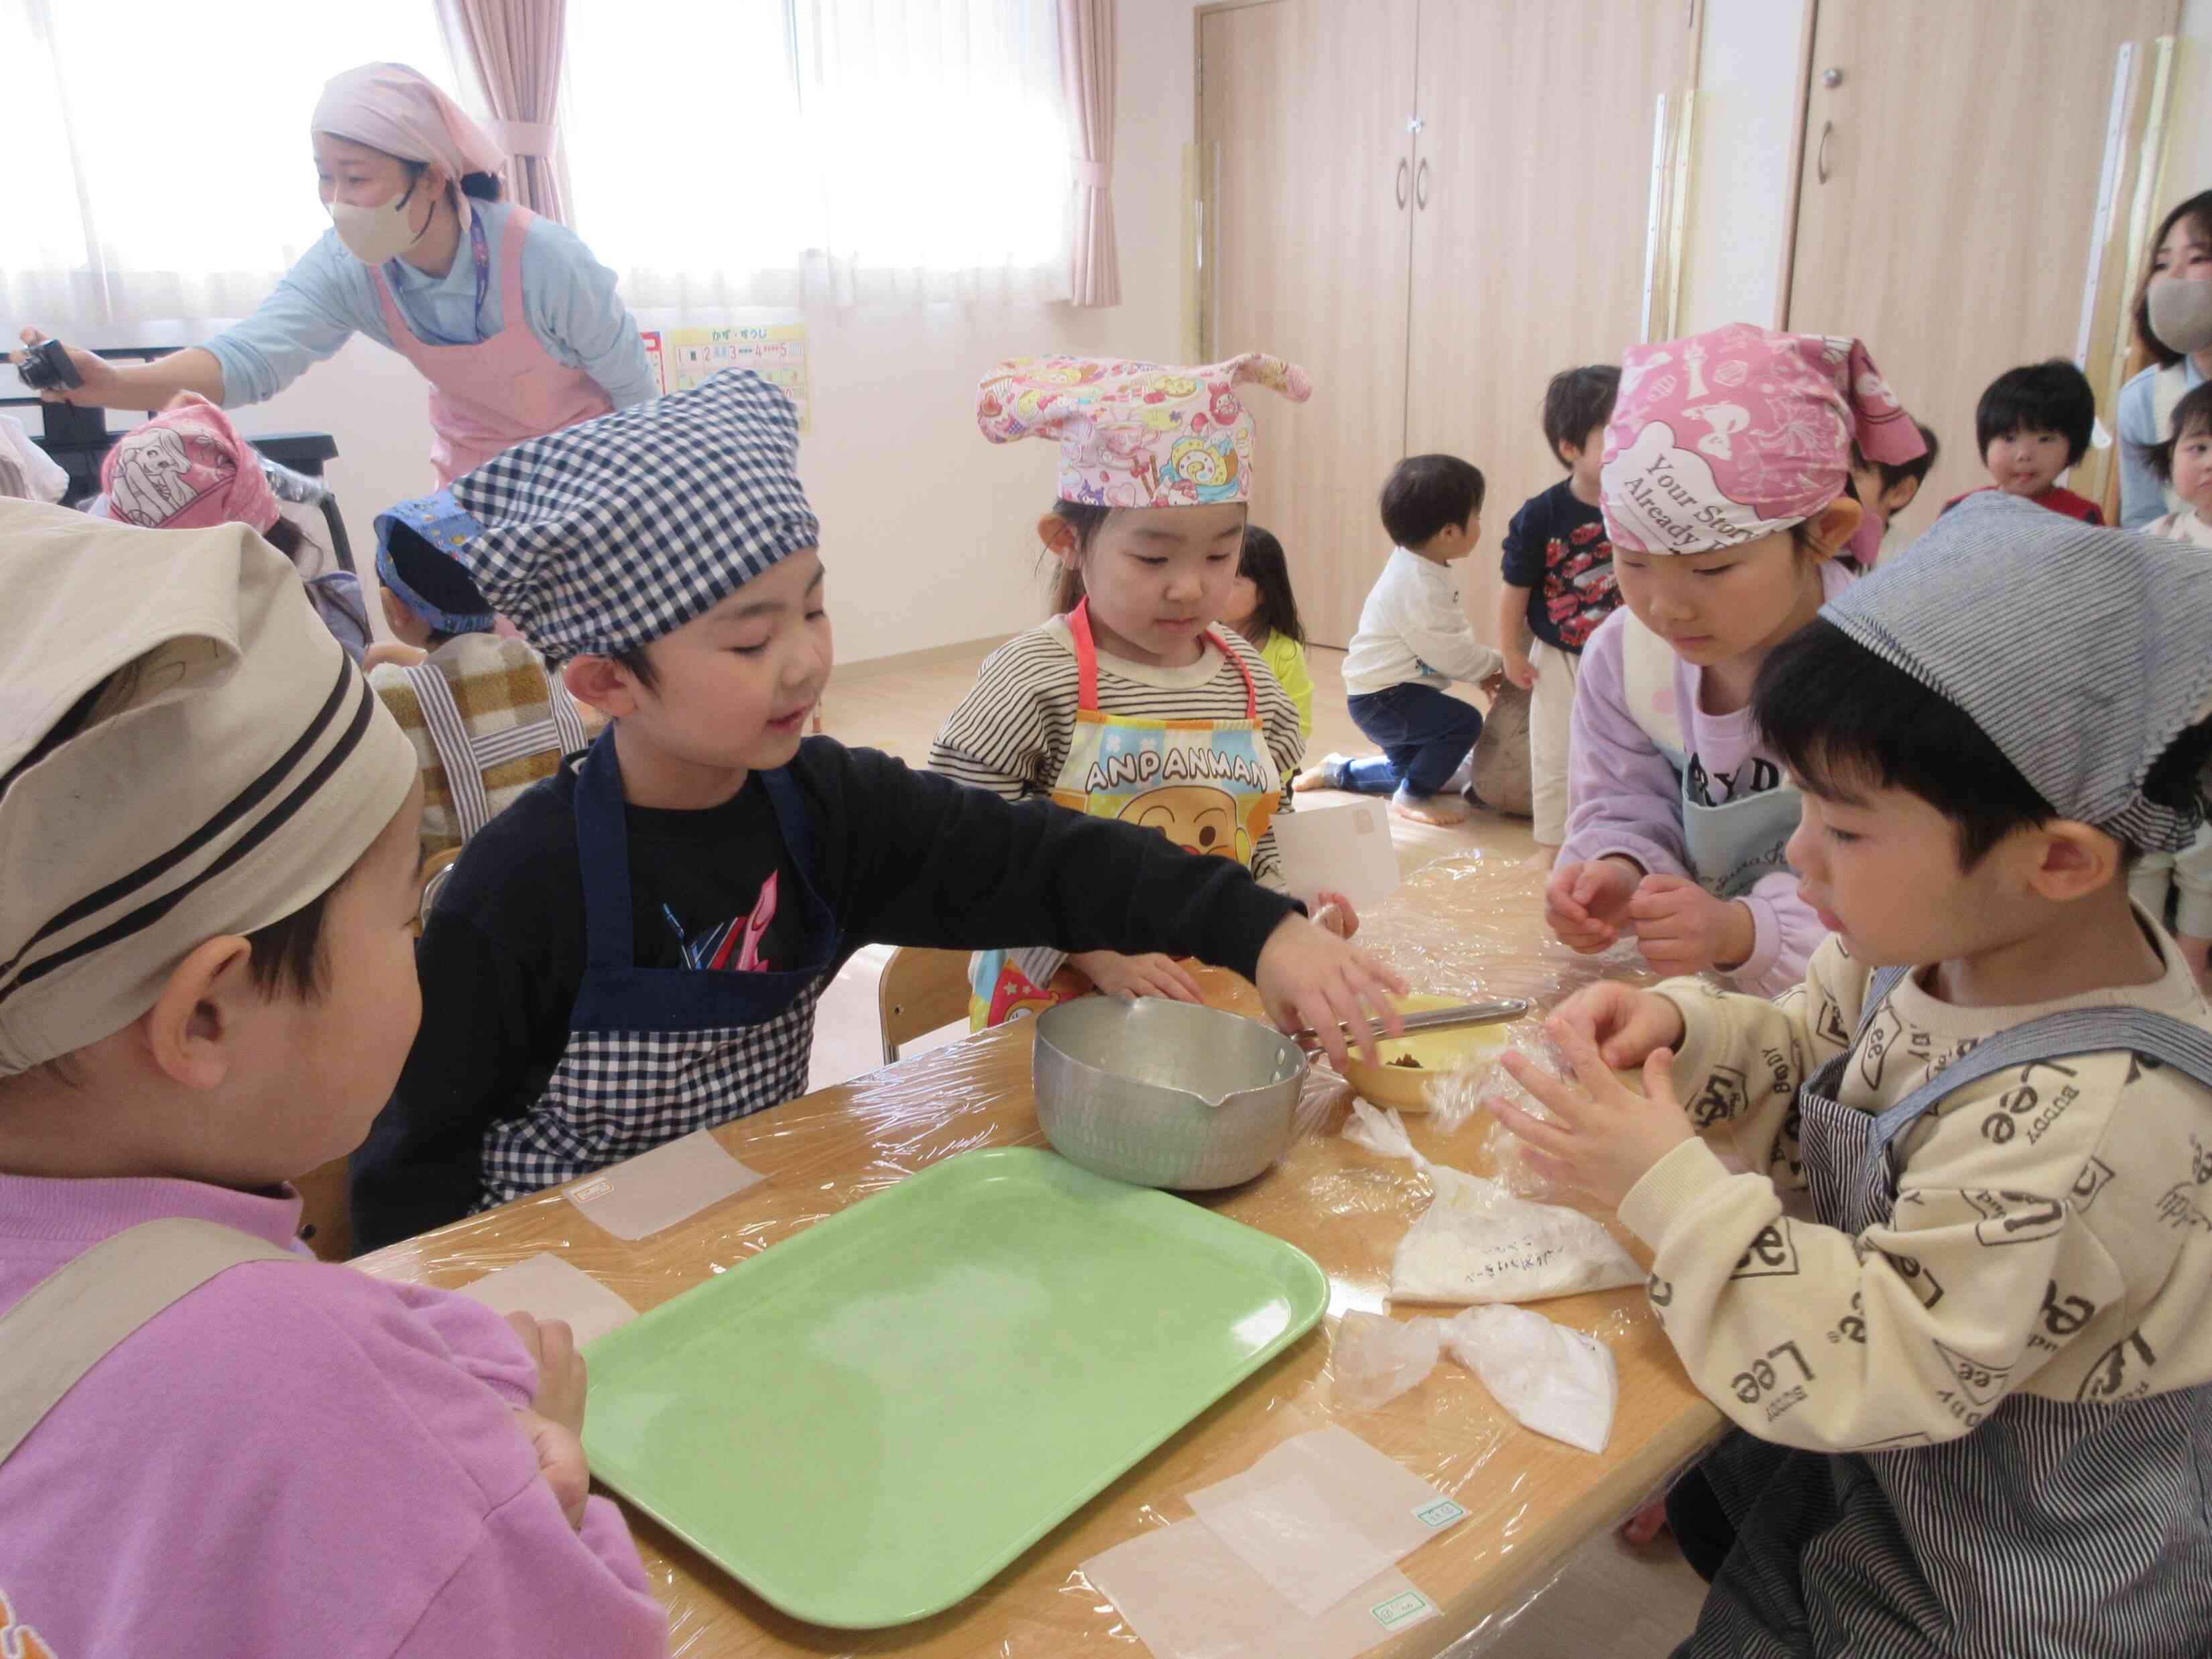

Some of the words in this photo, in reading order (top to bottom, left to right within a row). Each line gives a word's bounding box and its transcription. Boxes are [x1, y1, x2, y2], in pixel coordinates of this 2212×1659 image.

[704, 346, 711, 361] 2
[729, 345, 737, 359] 3
[755, 343, 762, 357] 4
[780, 343, 787, 357] 5
[1646, 454, 1697, 507] Your
[1624, 477, 1701, 546] Already
[1085, 747, 1268, 794] ANPANMAN
[1731, 1341, 1815, 1404] Lee
